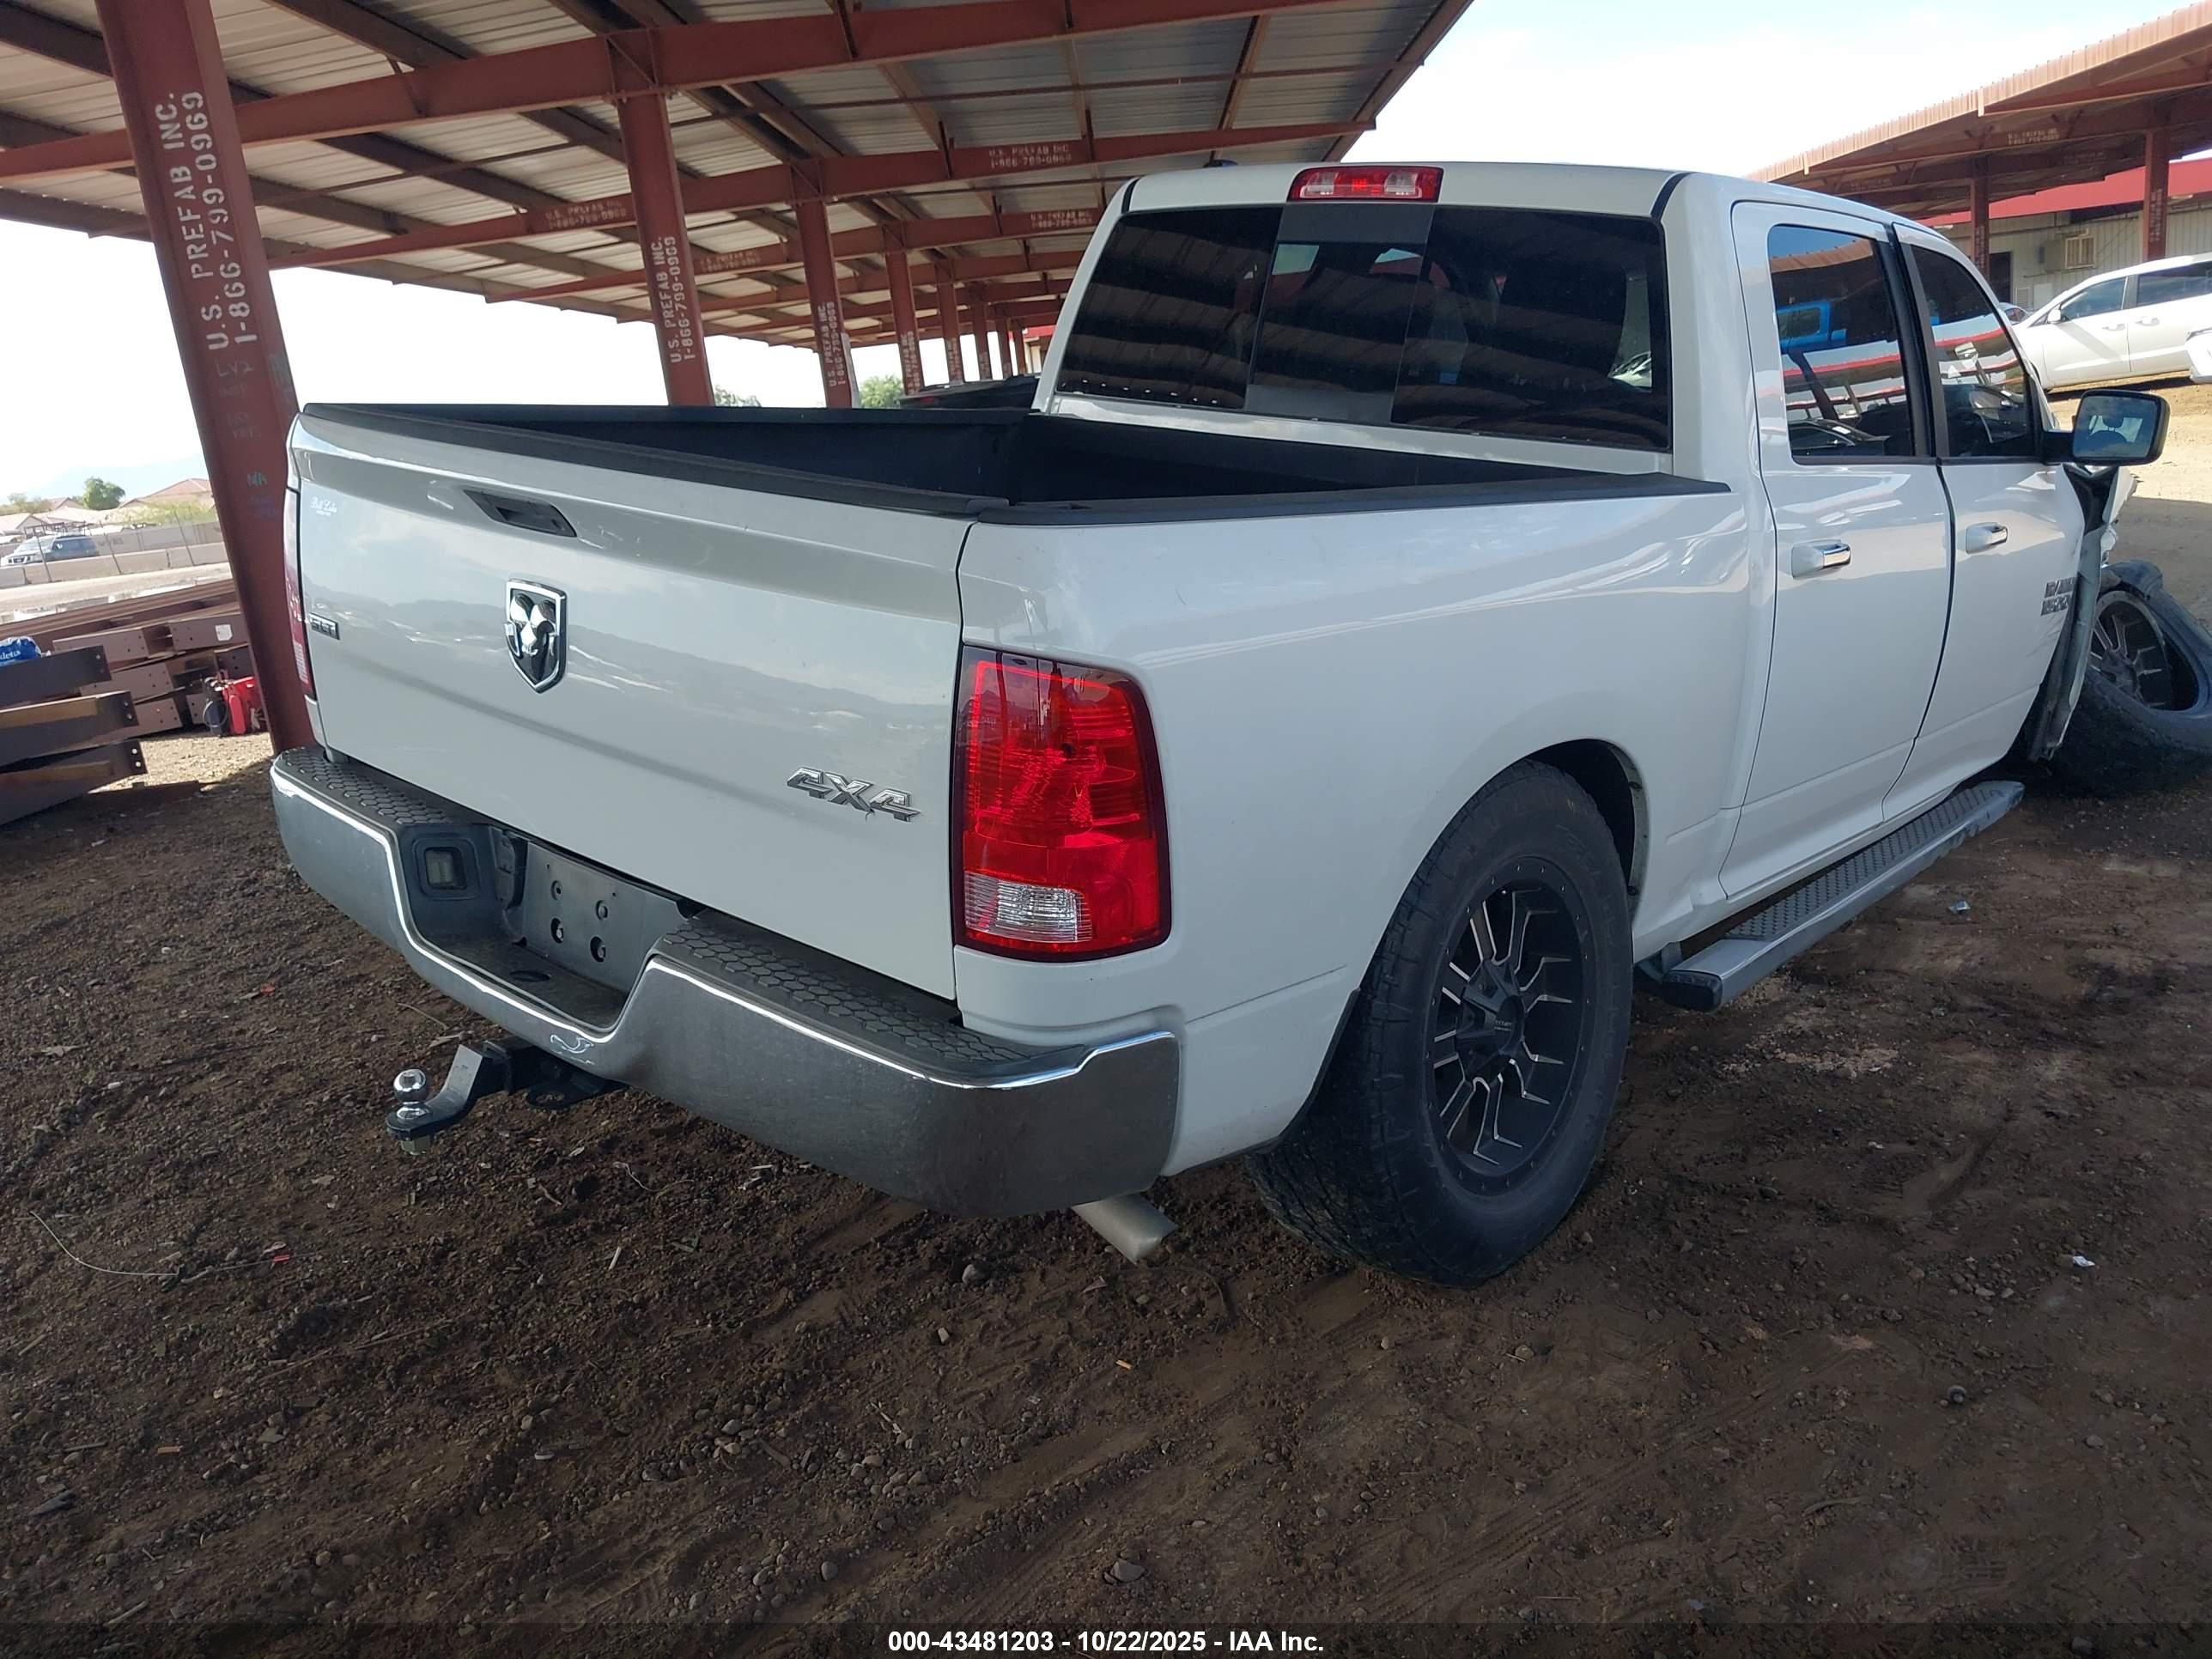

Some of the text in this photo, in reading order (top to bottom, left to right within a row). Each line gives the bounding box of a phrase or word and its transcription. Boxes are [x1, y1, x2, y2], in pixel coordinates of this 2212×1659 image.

[155, 92, 229, 350] U.S. PREFAB INC.
[181, 91, 258, 344] 1-866-799-0969
[656, 270, 677, 328] PREFAB
[664, 236, 696, 360] 1-866-799-0969
[667, 335, 682, 363] U.S.
